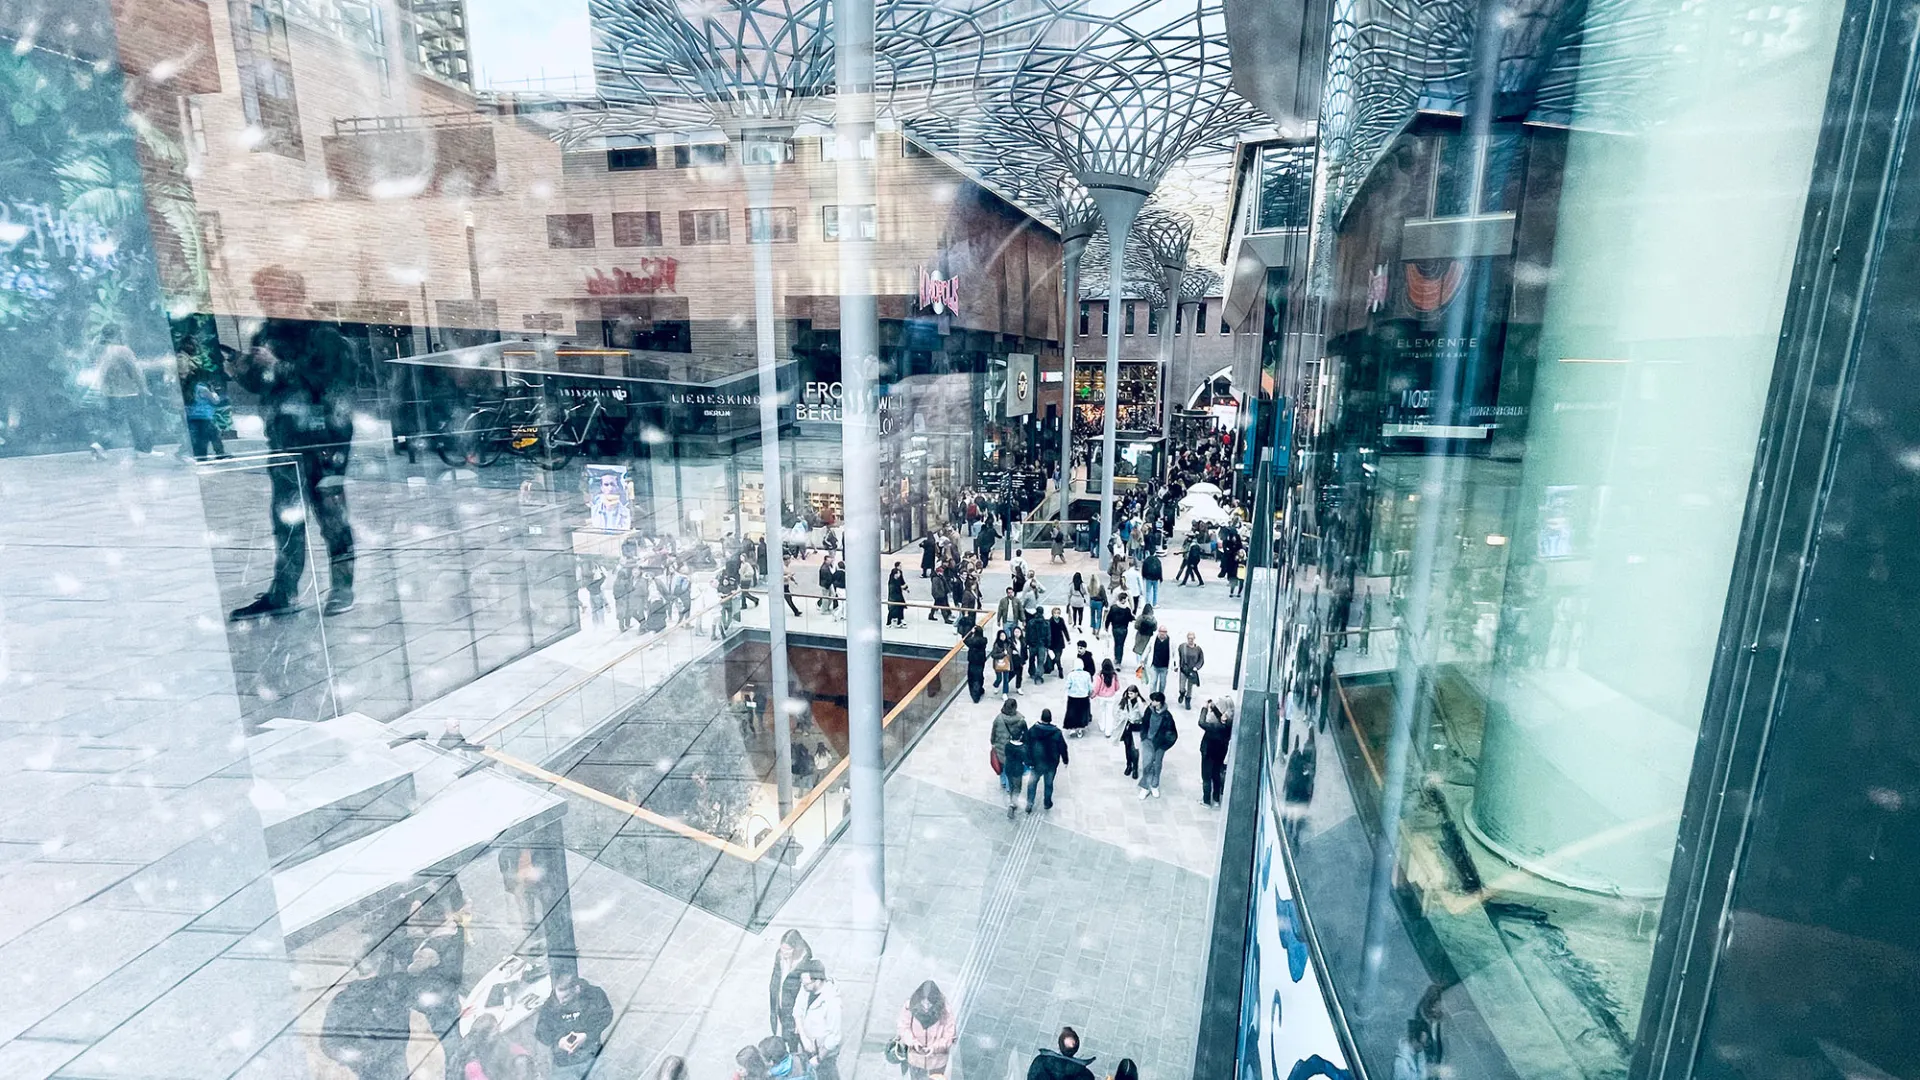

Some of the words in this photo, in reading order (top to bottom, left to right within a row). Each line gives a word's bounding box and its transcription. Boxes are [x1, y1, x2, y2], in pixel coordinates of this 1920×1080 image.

[1396, 338, 1478, 349] ELEMENTE
[805, 381, 844, 400] FRO
[796, 403, 844, 421] BERL
